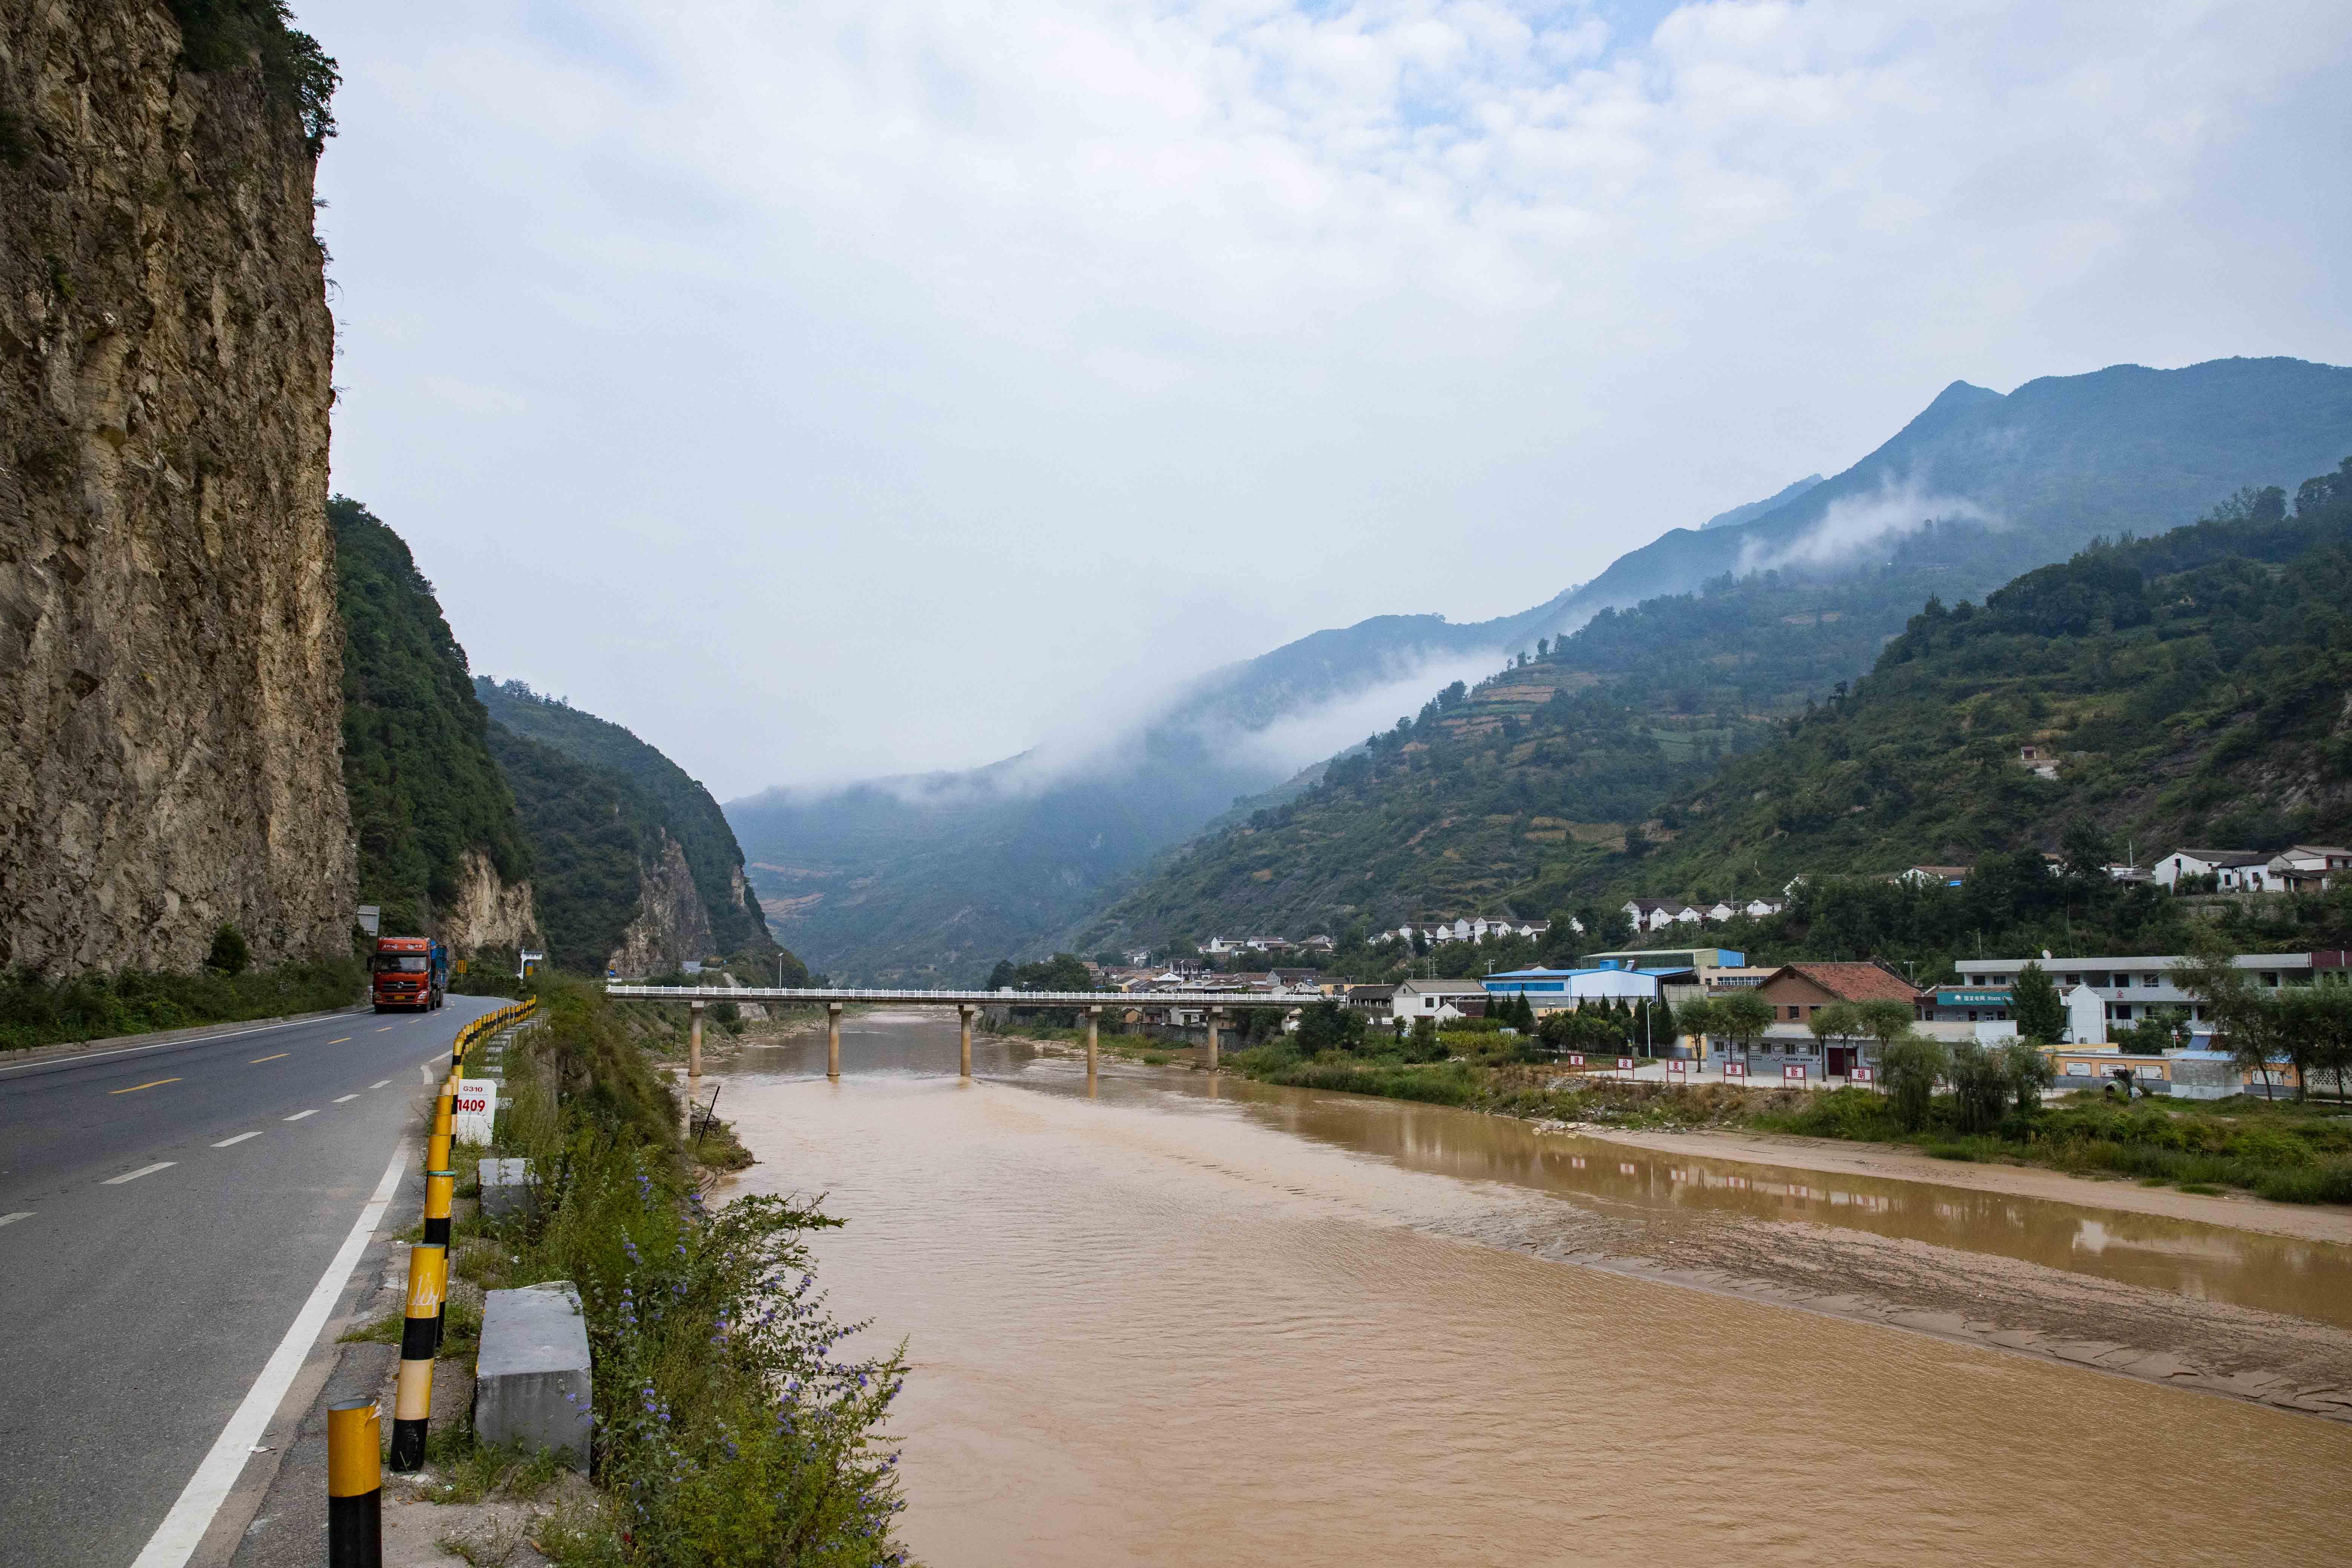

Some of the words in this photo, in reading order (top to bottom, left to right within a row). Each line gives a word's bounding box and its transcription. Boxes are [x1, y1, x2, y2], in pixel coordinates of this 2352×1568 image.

[1673, 1061, 1679, 1070] 美
[1730, 1065, 1737, 1074] 丽
[1790, 1067, 1798, 1077] 新
[1857, 1069, 1865, 1080] 胡
[458, 1099, 485, 1112] 1409
